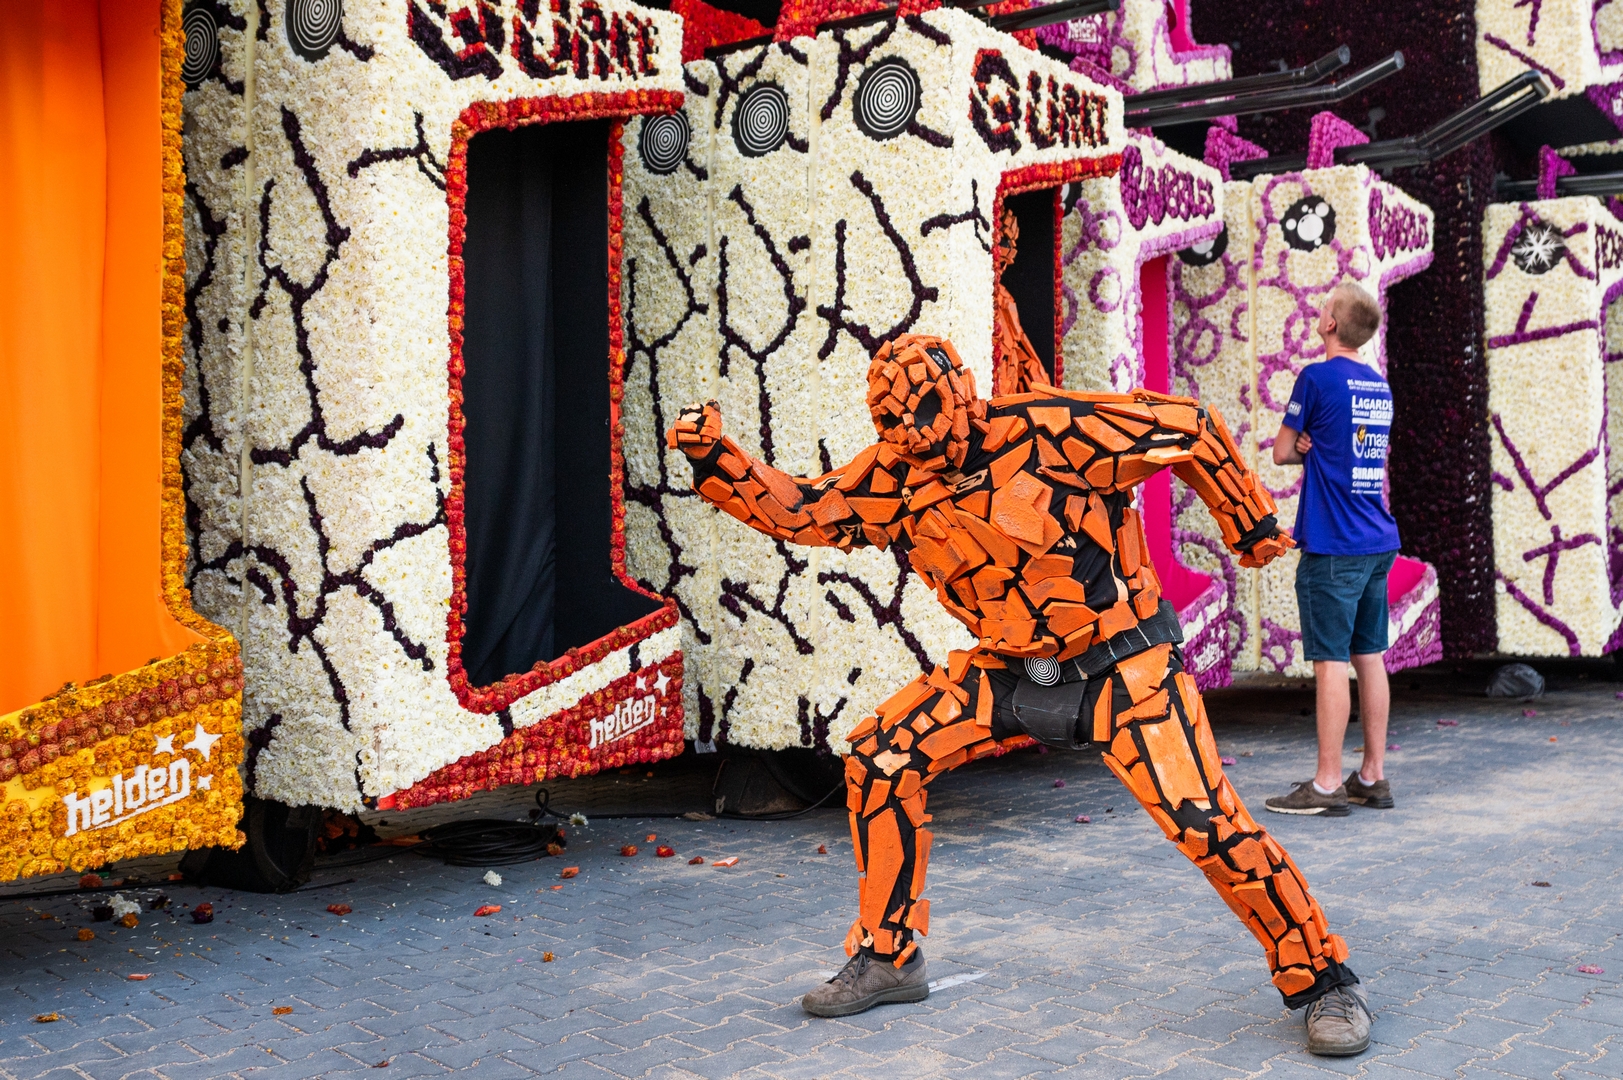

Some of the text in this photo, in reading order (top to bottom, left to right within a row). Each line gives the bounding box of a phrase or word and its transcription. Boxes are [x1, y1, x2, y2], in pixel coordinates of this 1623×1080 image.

[1351, 394, 1393, 411] LAGARDE
[588, 694, 656, 749] helden
[62, 757, 191, 838] helden
